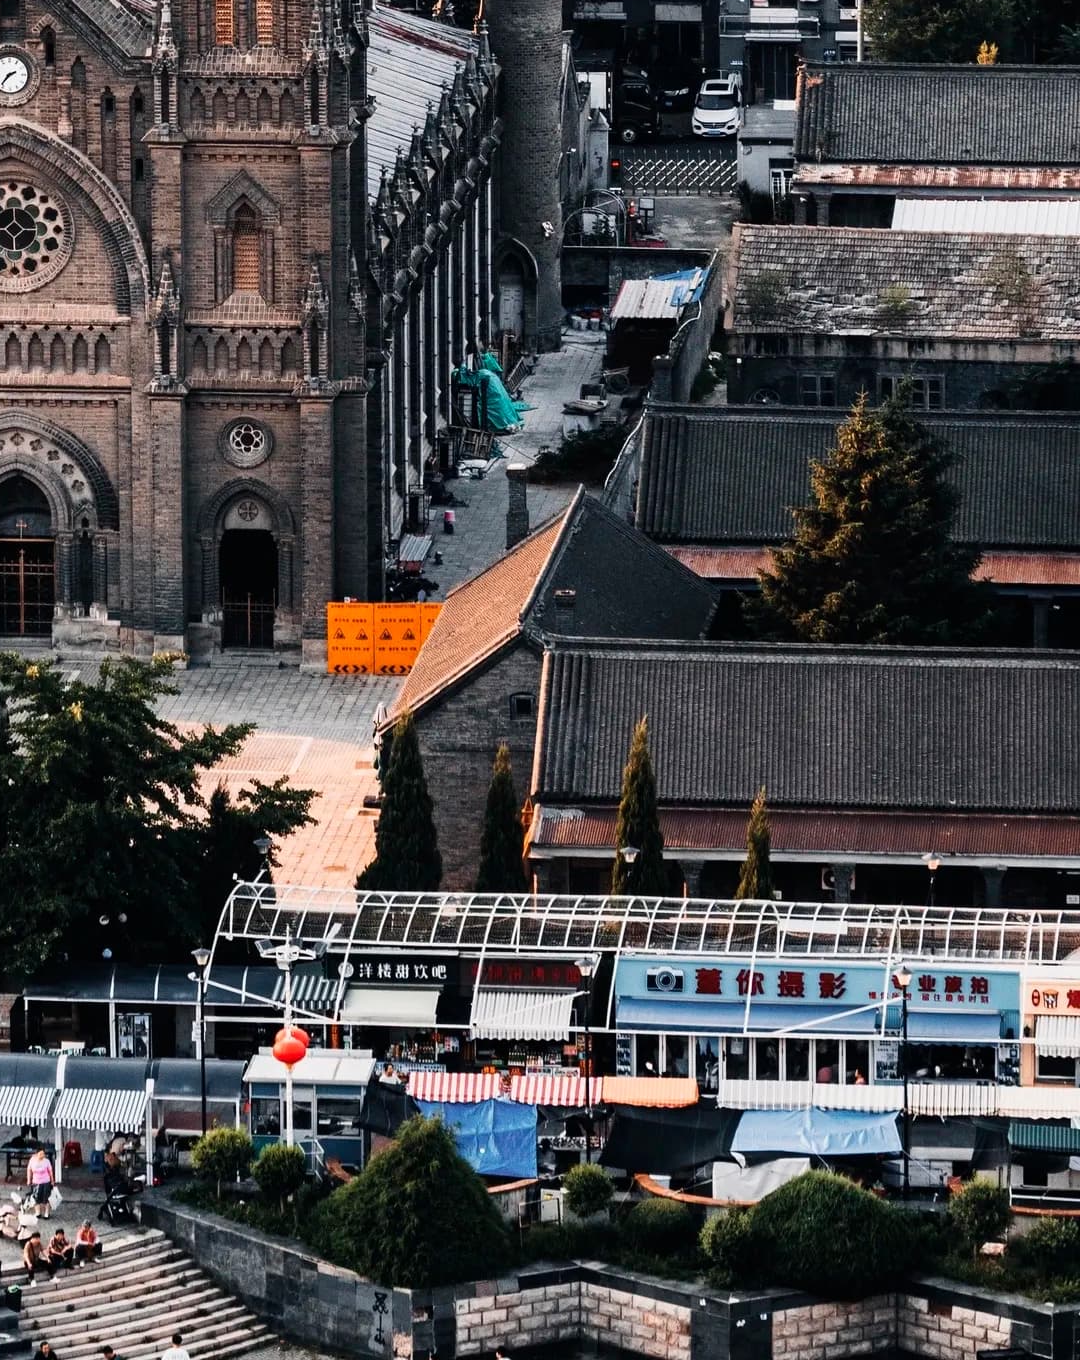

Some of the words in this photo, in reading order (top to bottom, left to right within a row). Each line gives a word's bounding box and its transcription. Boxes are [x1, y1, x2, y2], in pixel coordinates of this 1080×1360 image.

[359, 962, 447, 980] 洋楼甜饮吧
